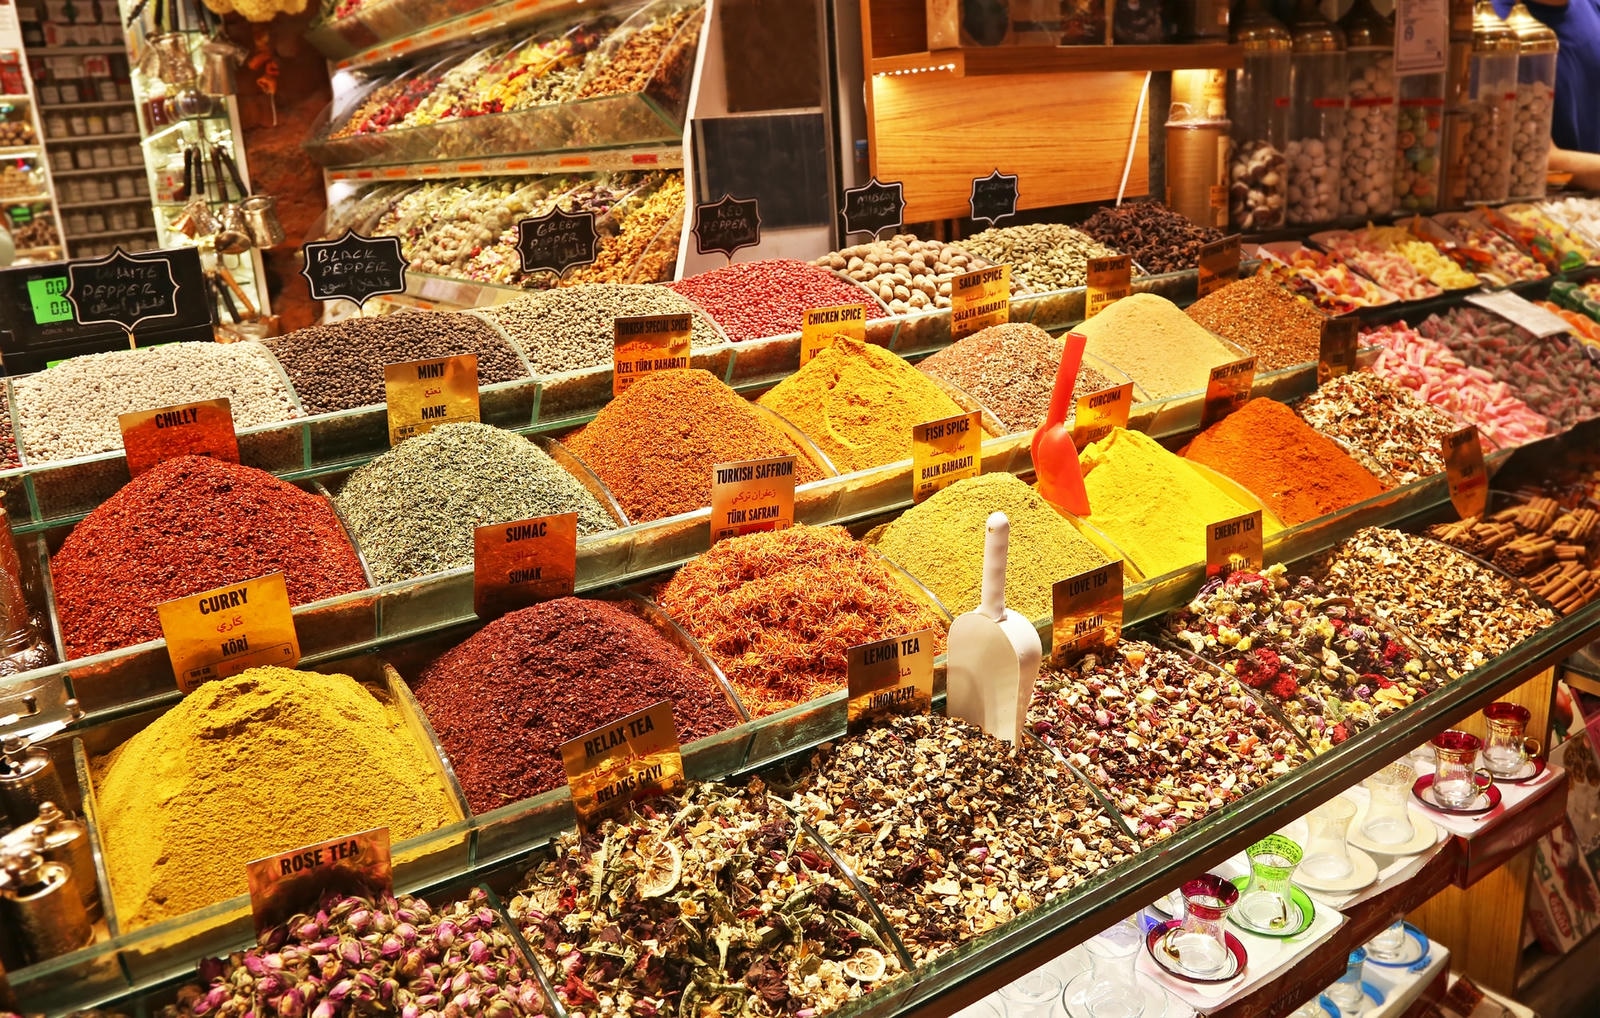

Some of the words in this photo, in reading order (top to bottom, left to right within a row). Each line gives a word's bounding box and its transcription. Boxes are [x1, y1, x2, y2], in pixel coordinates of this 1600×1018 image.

[537, 220, 580, 236] GREEN
[703, 218, 748, 232] PEPPER
[530, 232, 578, 249] PEPPER
[317, 248, 377, 263] BLACK
[96, 266, 157, 280] WHITE
[322, 262, 391, 276] PEPPER
[959, 275, 981, 290] SALAD
[982, 269, 1003, 283] SPICE
[83, 282, 156, 299] PEPPER
[808, 310, 839, 326] CHICKEN
[841, 308, 862, 321] SPICE
[954, 309, 976, 322] SALATA
[977, 300, 1007, 316] BAHARATI
[617, 320, 645, 336] TURKISH
[645, 318, 670, 333] SPECIAL
[671, 317, 689, 331] SPICE
[418, 362, 445, 380] MINT
[617, 360, 633, 374] ÖZEL
[635, 357, 652, 372] TÜRK
[654, 356, 687, 370] BAHARATI
[1088, 390, 1121, 409] CURCUMA
[155, 408, 199, 430] CHILLY
[421, 405, 448, 421] NANE
[926, 426, 945, 442] FISH
[946, 418, 970, 436] SPICE
[717, 466, 755, 485] TURKISH
[755, 461, 793, 480] SAFFRON
[922, 466, 941, 480] BALIK
[942, 456, 973, 475] BAHARATI
[727, 509, 747, 525] TÜRK
[748, 505, 780, 522] SAFRANI
[505, 522, 547, 544] SUMAC
[1214, 523, 1241, 541] ENERGY
[1243, 517, 1255, 531] TEA
[508, 567, 542, 585] SUMAK
[1069, 577, 1090, 597] LOVE
[1091, 571, 1108, 587] TEA
[198, 588, 249, 615] CURRY
[216, 616, 244, 634] كاري
[221, 635, 249, 657] KÖRİ
[864, 644, 899, 666] LEMON
[900, 638, 920, 657] TEA
[584, 729, 627, 759] RELAX
[628, 714, 655, 738] TEA
[596, 776, 636, 804] RELAKS
[280, 852, 325, 876] ROSE
[328, 839, 360, 863] TEA
